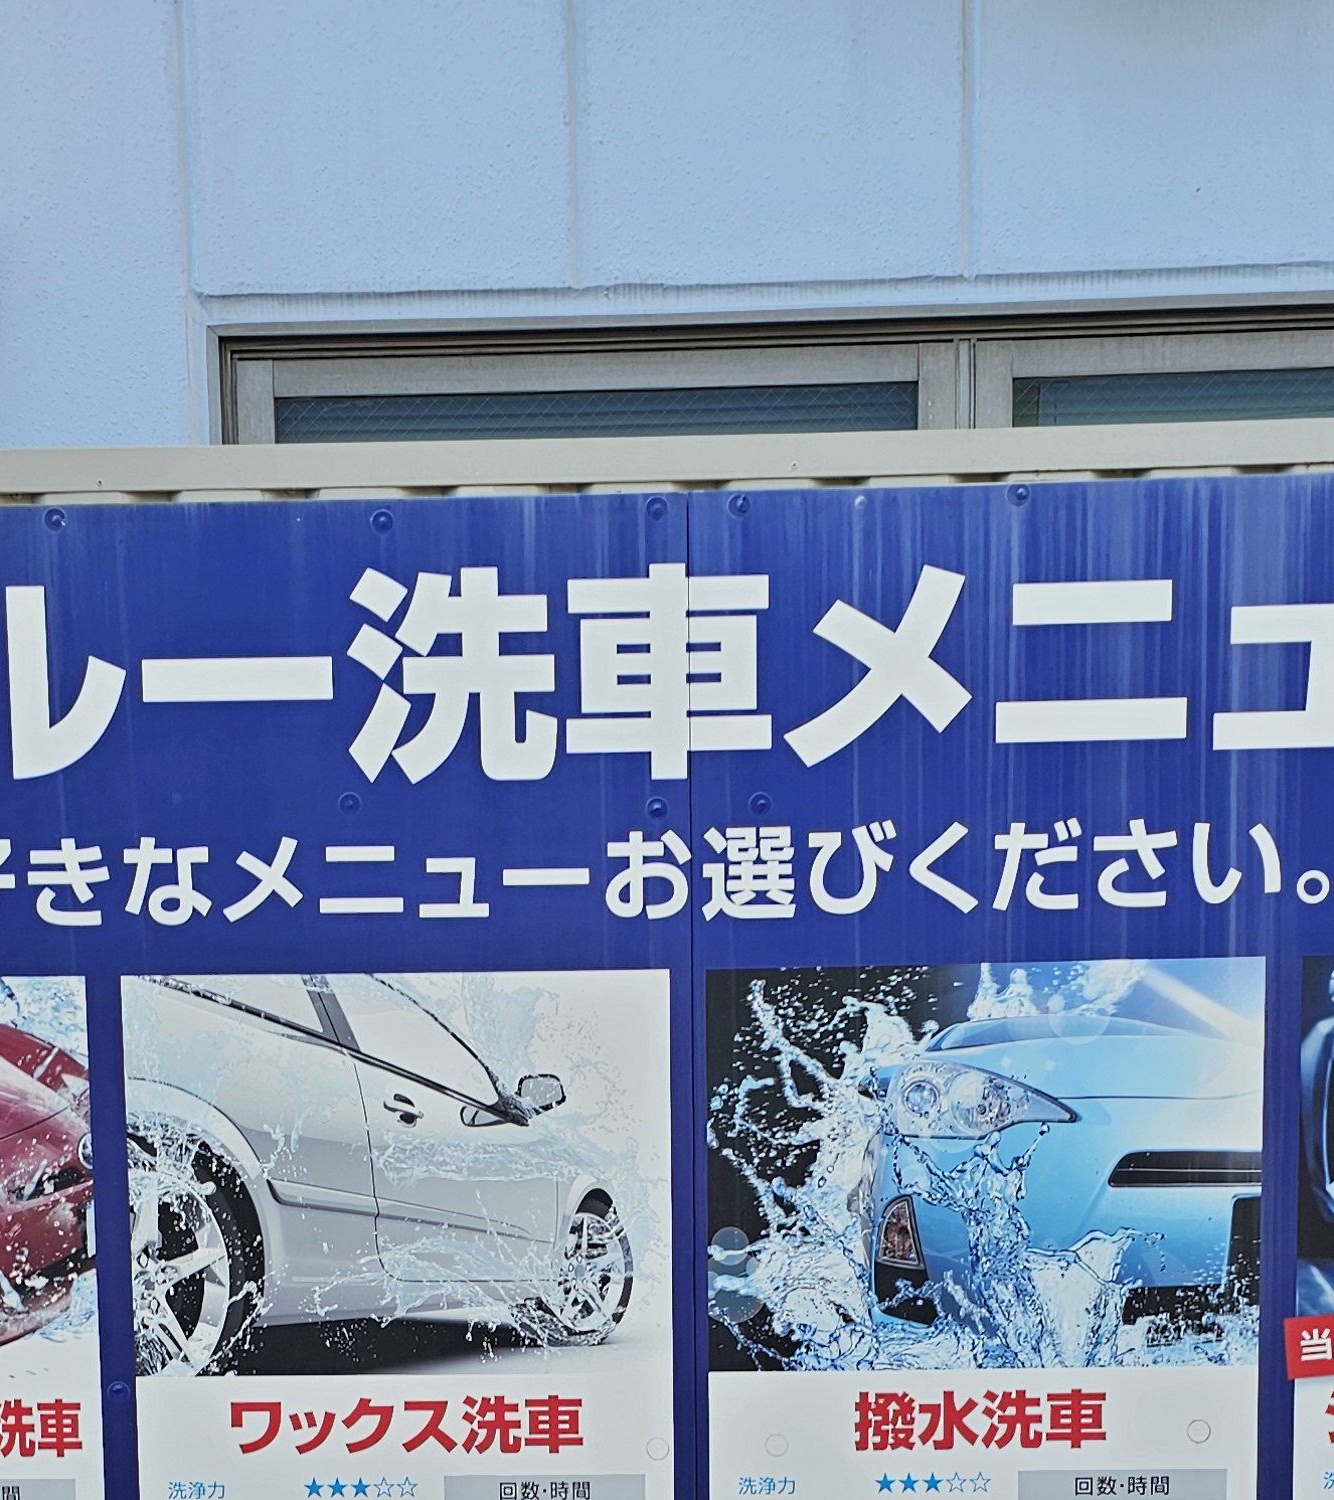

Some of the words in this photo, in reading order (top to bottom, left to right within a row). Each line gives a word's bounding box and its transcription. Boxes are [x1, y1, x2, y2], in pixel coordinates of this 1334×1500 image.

[230, 1394, 584, 1456] ワックス洗車
[854, 1388, 1107, 1452] 撥水洗車
[168, 1481, 225, 1500] 洗浄力
[738, 1476, 796, 1495] 洗浄力
